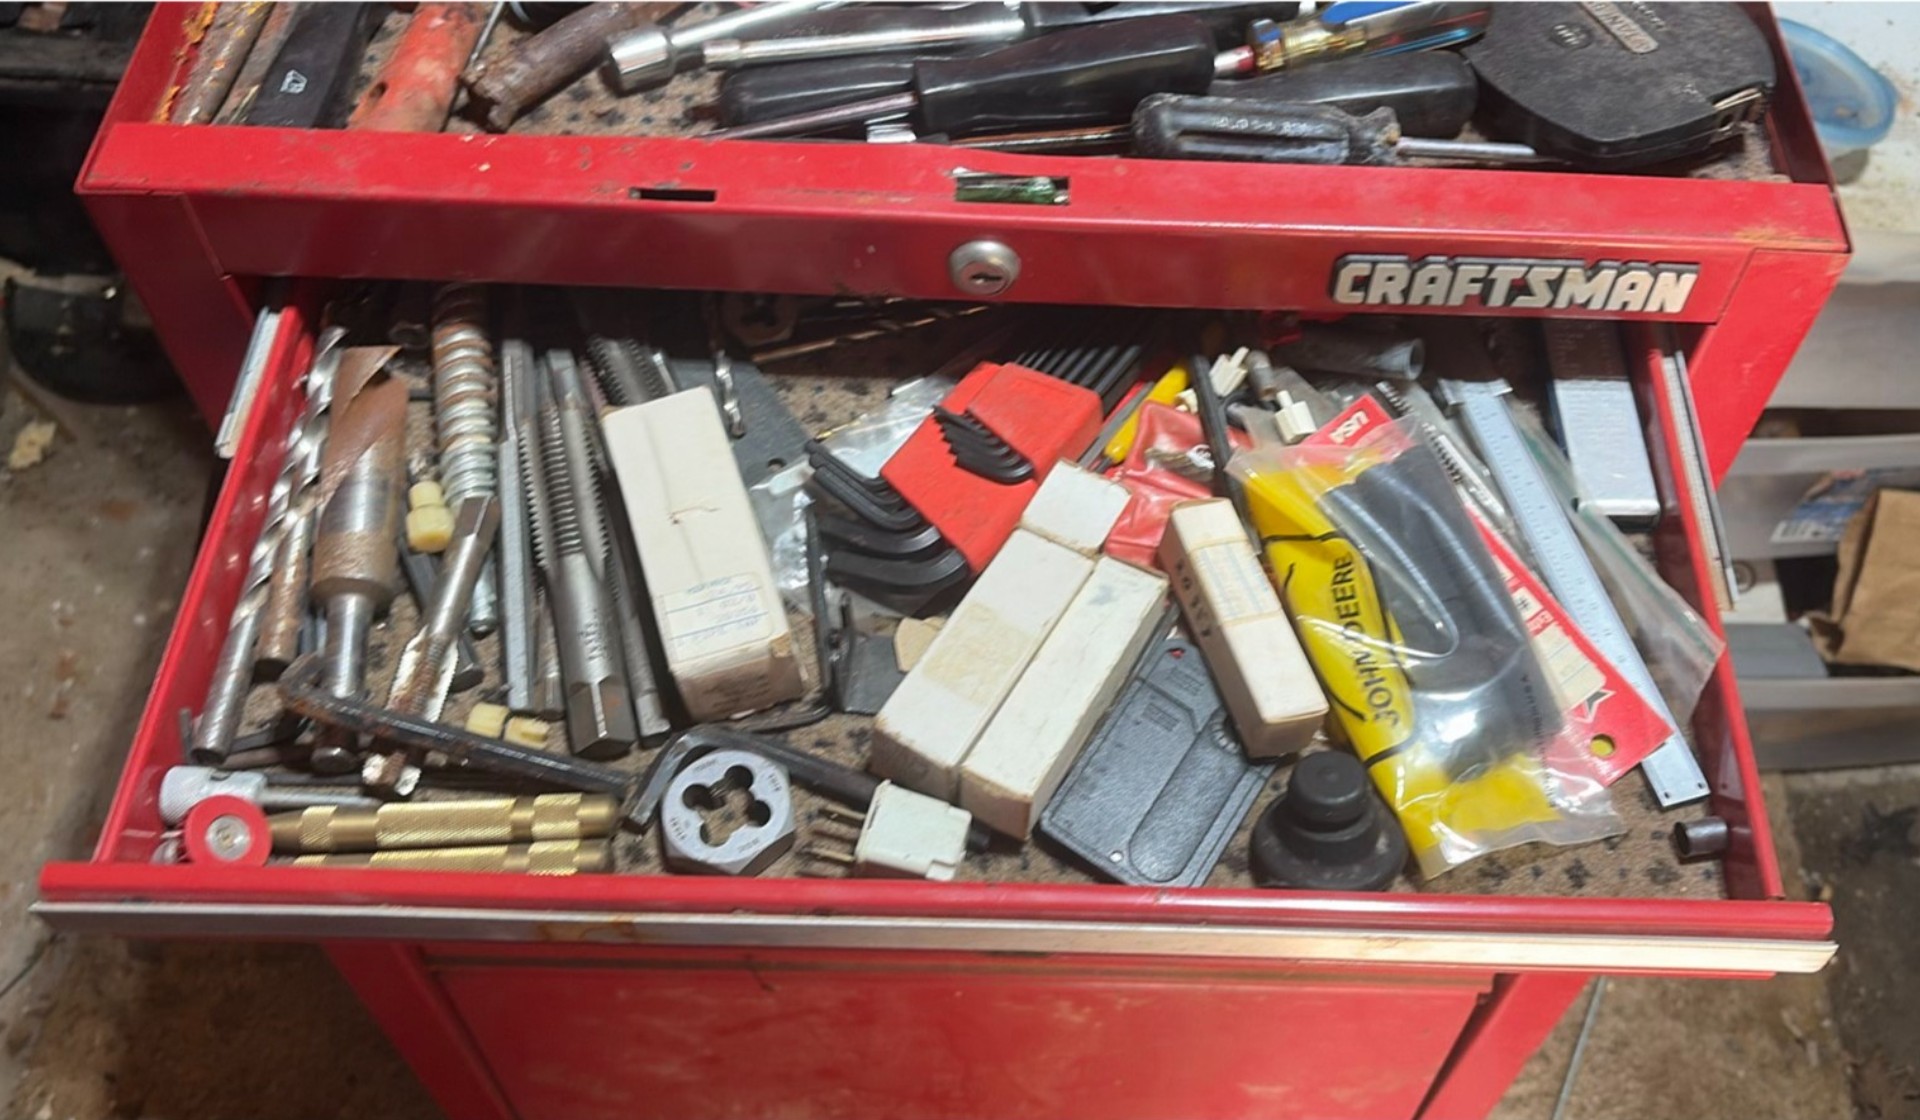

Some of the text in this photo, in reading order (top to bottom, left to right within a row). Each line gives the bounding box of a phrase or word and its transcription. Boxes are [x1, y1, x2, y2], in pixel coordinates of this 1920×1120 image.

[1332, 257, 1699, 314] CRAFTSMAN
[1329, 410, 1369, 444] USA
[1333, 552, 1399, 728] JOHN DEERE
